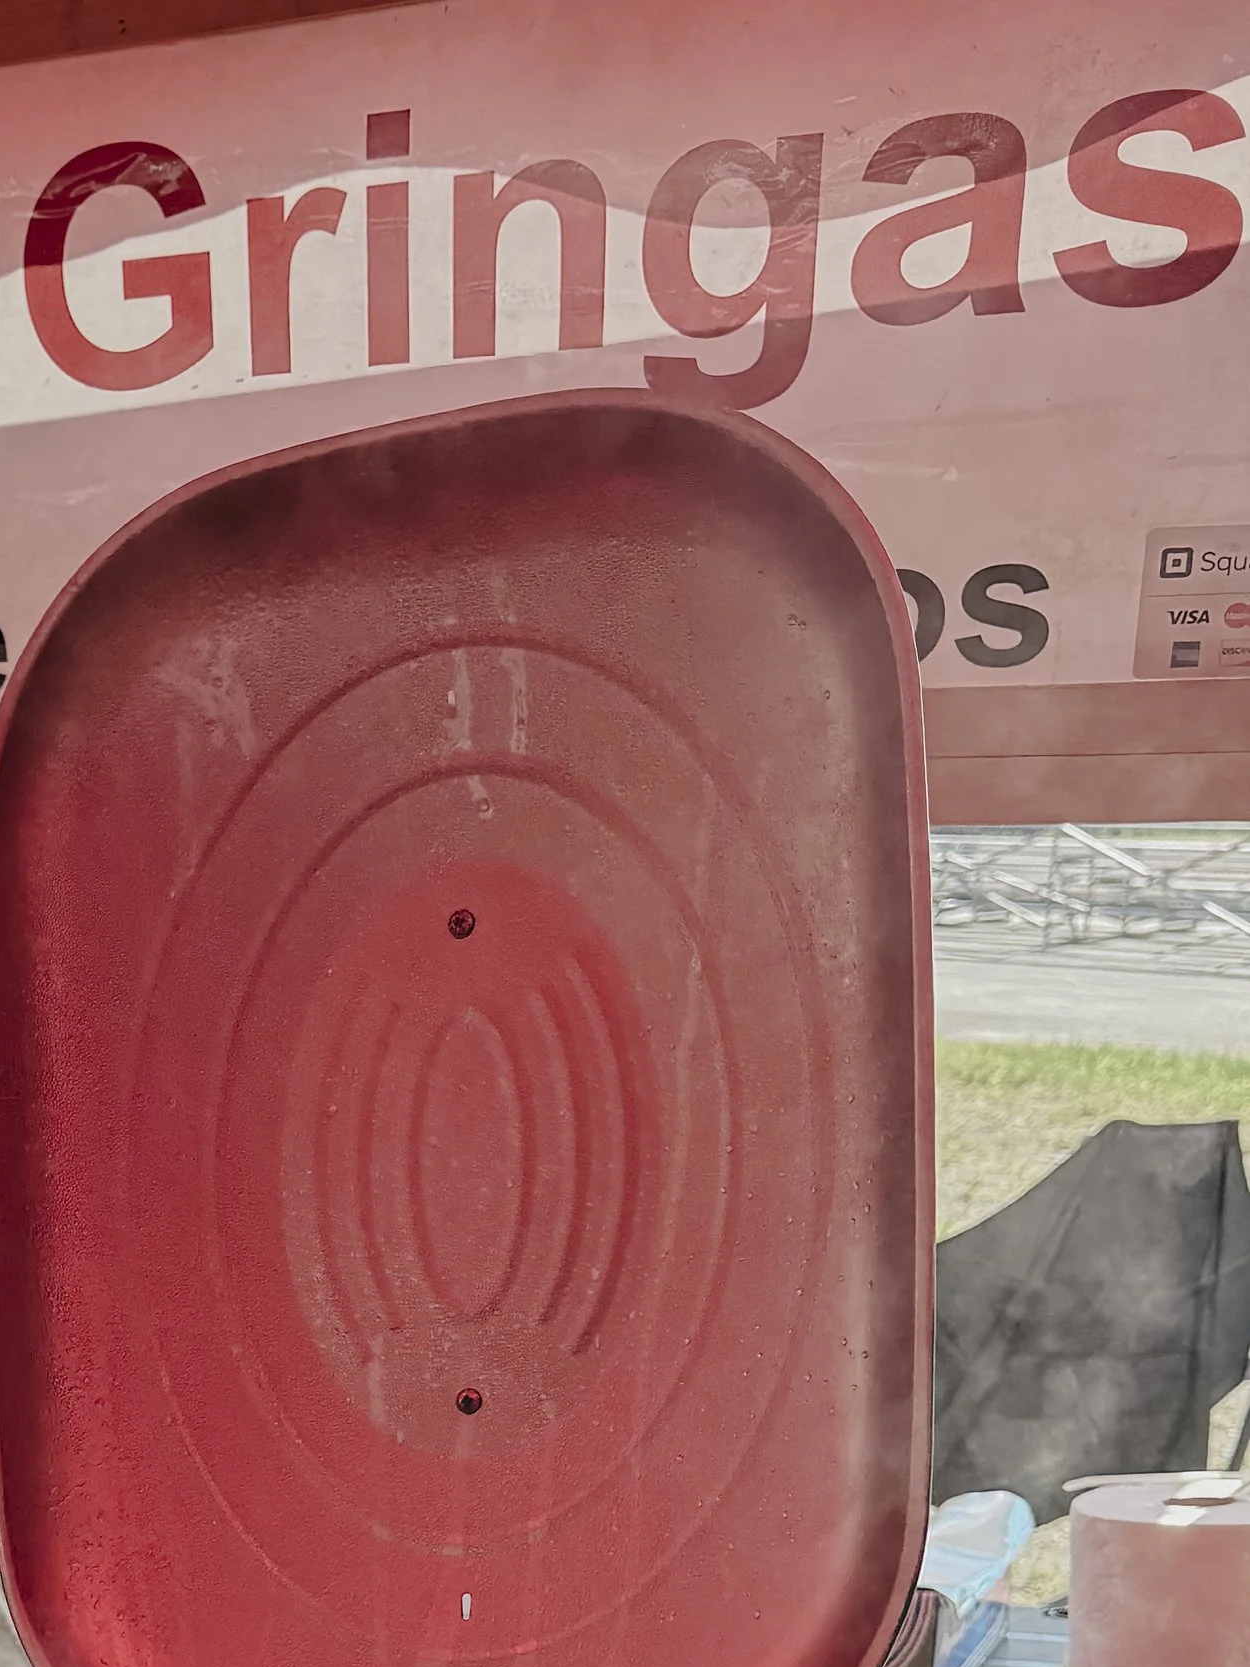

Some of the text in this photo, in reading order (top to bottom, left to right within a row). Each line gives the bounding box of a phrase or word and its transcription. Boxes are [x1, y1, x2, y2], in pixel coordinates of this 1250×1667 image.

[22, 88, 1247, 411] Gringas
[1200, 550, 1250, 576] Squ
[1166, 609, 1210, 625] VISA
